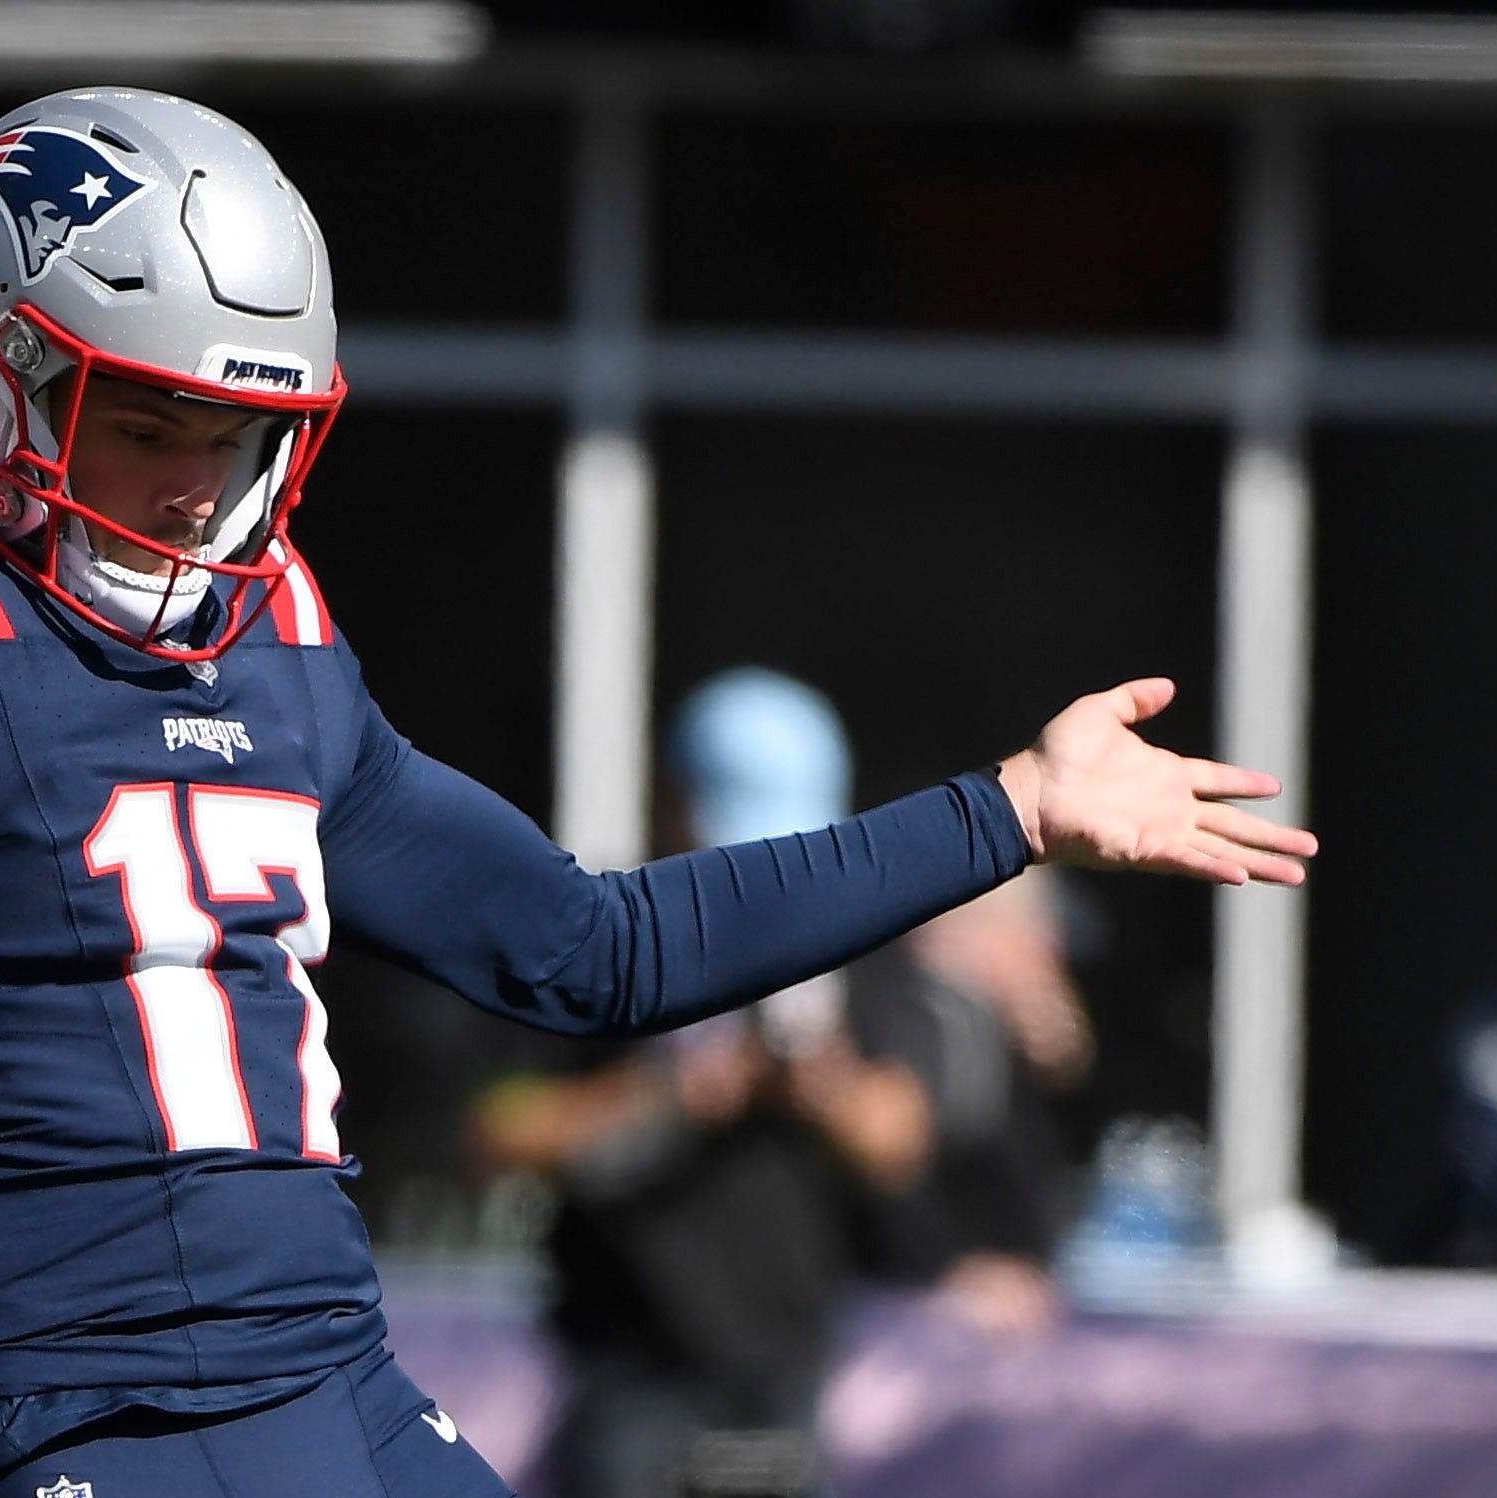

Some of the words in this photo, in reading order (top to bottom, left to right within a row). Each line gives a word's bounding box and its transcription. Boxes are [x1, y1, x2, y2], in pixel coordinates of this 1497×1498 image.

[222, 358, 305, 393] PATRIOTS
[162, 718, 254, 754] PATRIOTS
[82, 781, 342, 1163] 17
